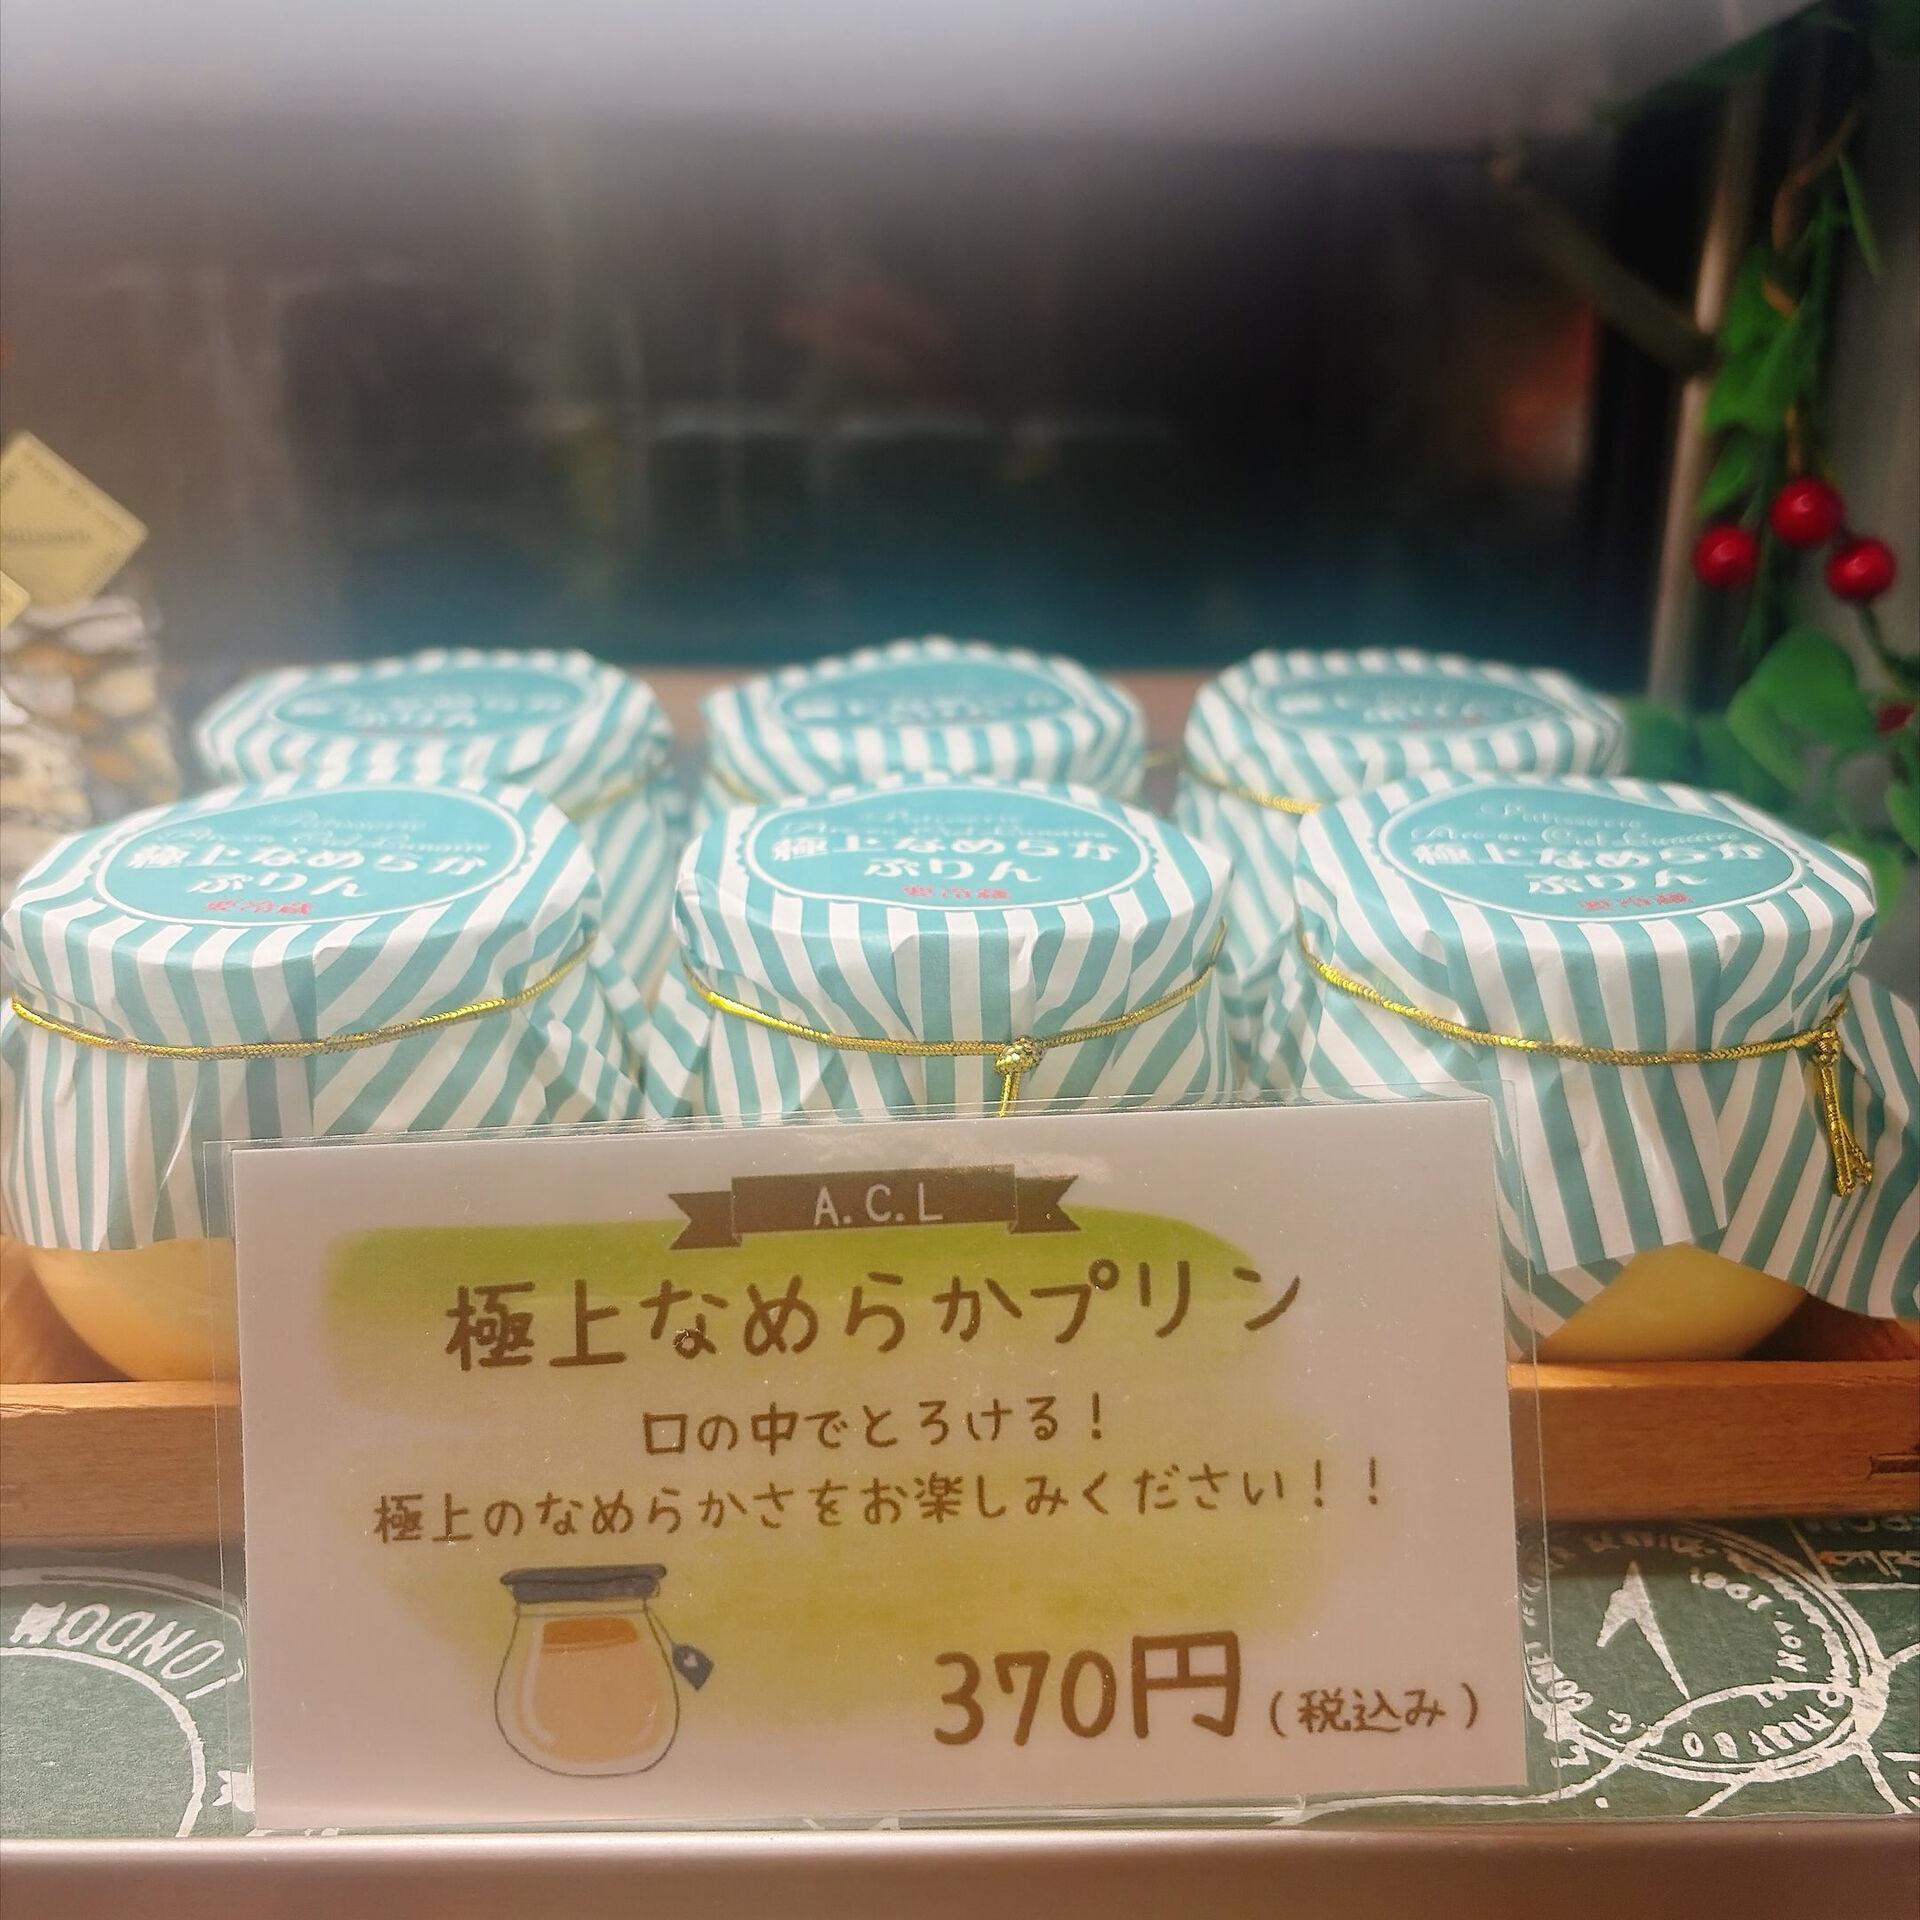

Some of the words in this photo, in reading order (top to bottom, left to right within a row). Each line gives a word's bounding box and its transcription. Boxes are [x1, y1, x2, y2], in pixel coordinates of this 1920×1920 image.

[128, 843, 489, 876] 極上なめらか
[772, 835, 1120, 861] 極上なめらか
[1412, 842, 1764, 869] 極上なめらか
[186, 870, 368, 898] ぷりん
[864, 858, 1042, 883] ぷりん
[1525, 868, 1711, 895] ぷりん
[813, 1182, 943, 1227] A.C.L
[445, 1258, 1301, 1372] 極上なめらかプリン
[642, 1390, 1103, 1457] 口の中でとろける！
[373, 1455, 1379, 1545] 極上のなめらかさをお楽しみください！！
[934, 1629, 1241, 1747] 370円
